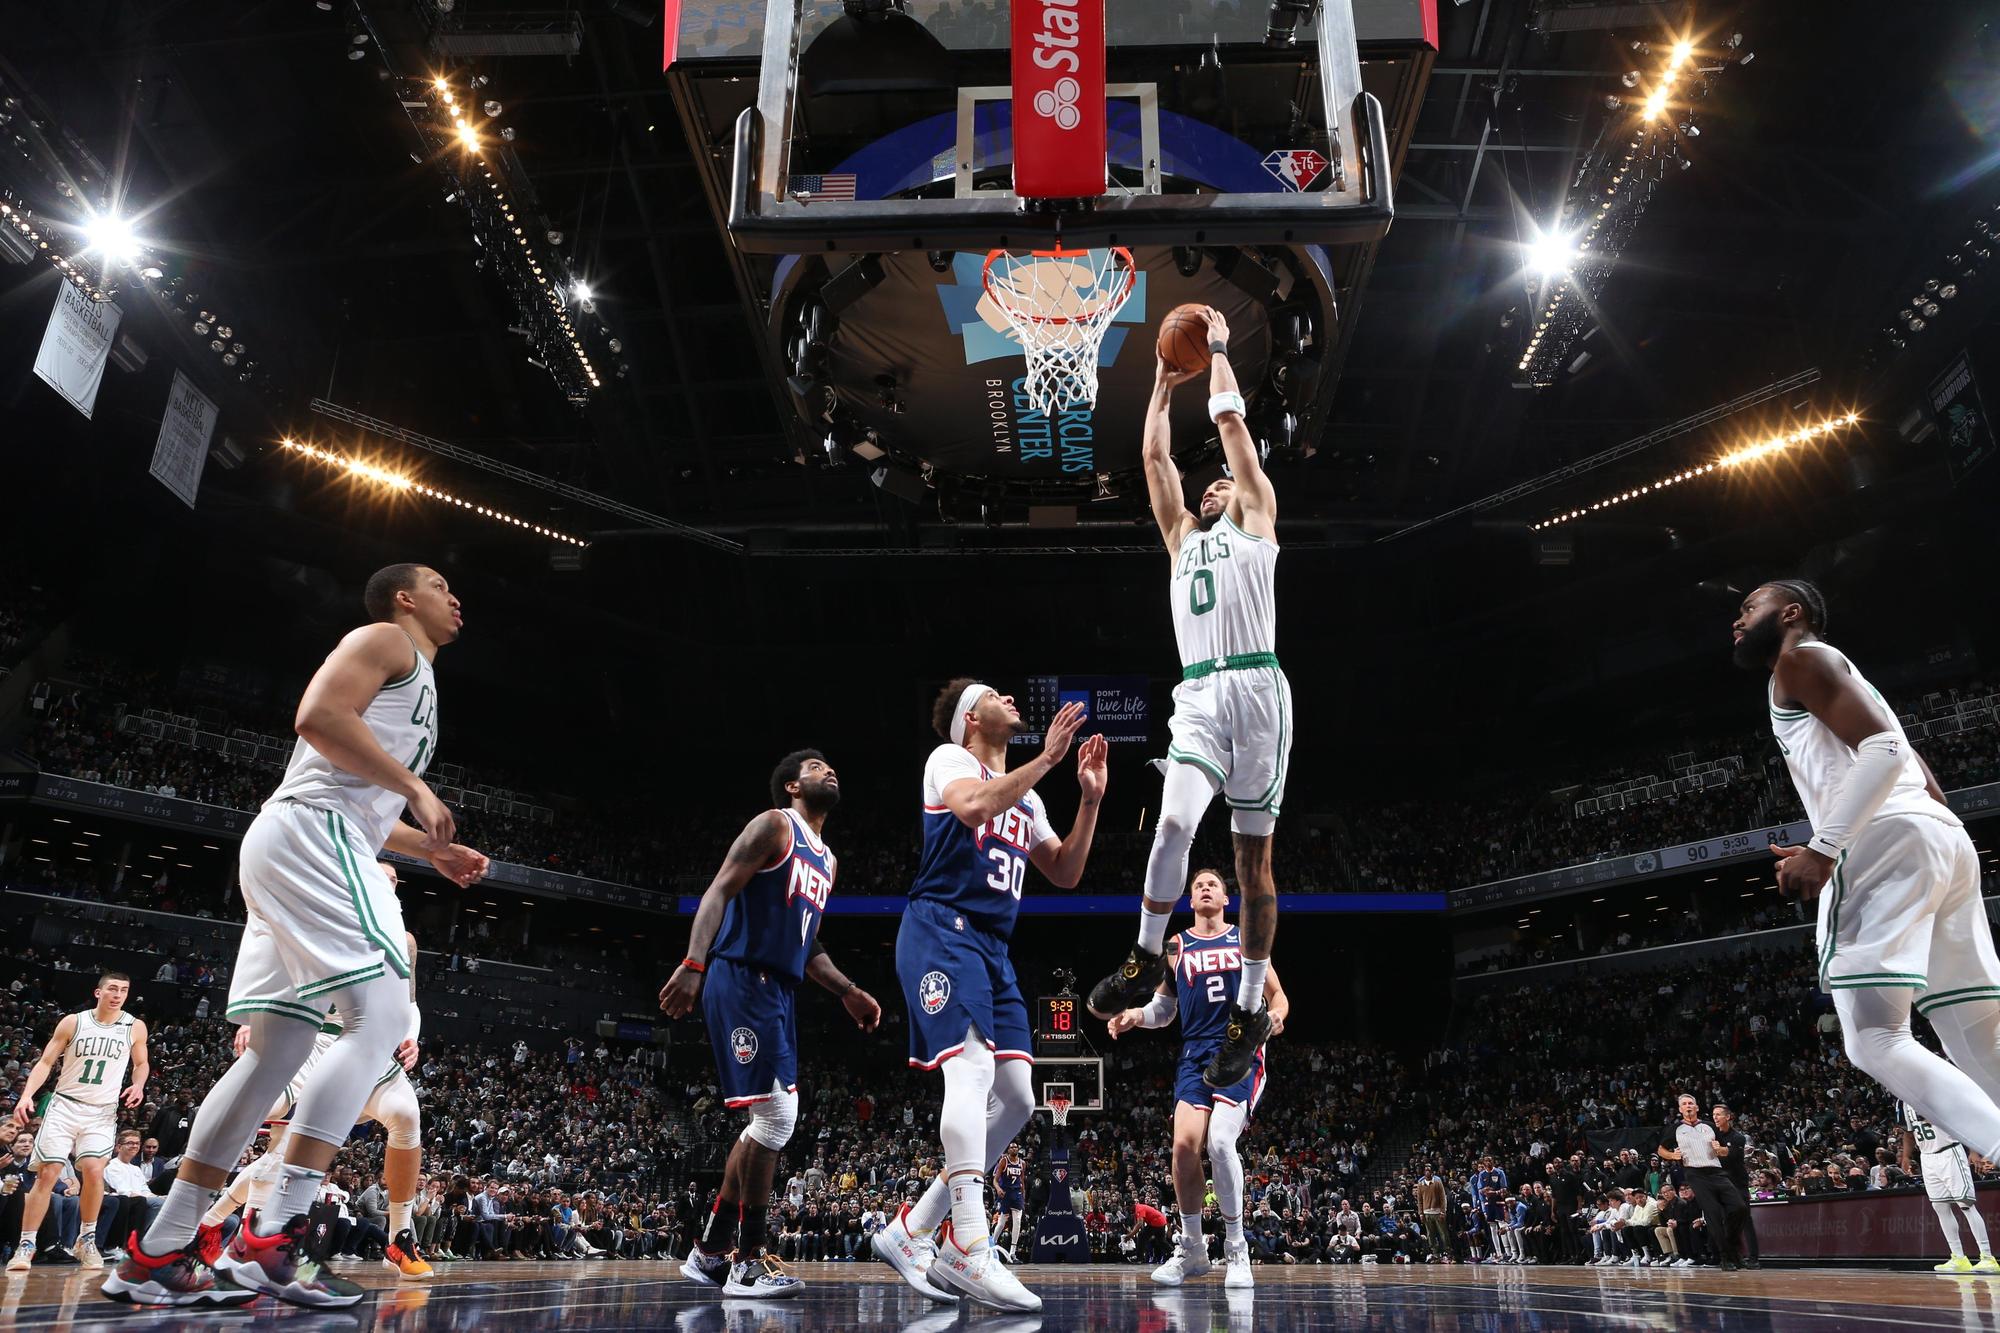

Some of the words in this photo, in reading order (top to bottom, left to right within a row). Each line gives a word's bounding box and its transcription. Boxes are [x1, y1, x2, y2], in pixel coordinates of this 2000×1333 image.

[1301, 157, 1314, 170] 75
[65, 290, 109, 341] BASKETBALL
[1934, 368, 1971, 413] CHAMPIONS
[183, 389, 205, 418] NETS
[174, 397, 208, 439] BASKETBALL
[986, 379, 1012, 453] BROOKLYN
[1190, 569, 1216, 616] 0
[1097, 699, 1122, 712] live
[1124, 696, 1147, 712] life
[1723, 836, 1749, 850] 9:30
[1767, 829, 1790, 845] 84
[1688, 845, 1708, 862] 90
[788, 857, 832, 910] NETS
[987, 848, 1025, 900] 30
[1183, 948, 1240, 982] NETS
[1206, 976, 1226, 1002] 2
[1050, 1001, 1073, 1012] 9:29
[1054, 1012, 1070, 1030] 18
[75, 1036, 124, 1060] CELTICS
[78, 1058, 106, 1085] 11
[1912, 1122, 1936, 1141] 36
[1006, 1167, 1022, 1176] NETS
[1011, 1176, 1017, 1184] 7
[1881, 1215, 1936, 1234] TURKISH
